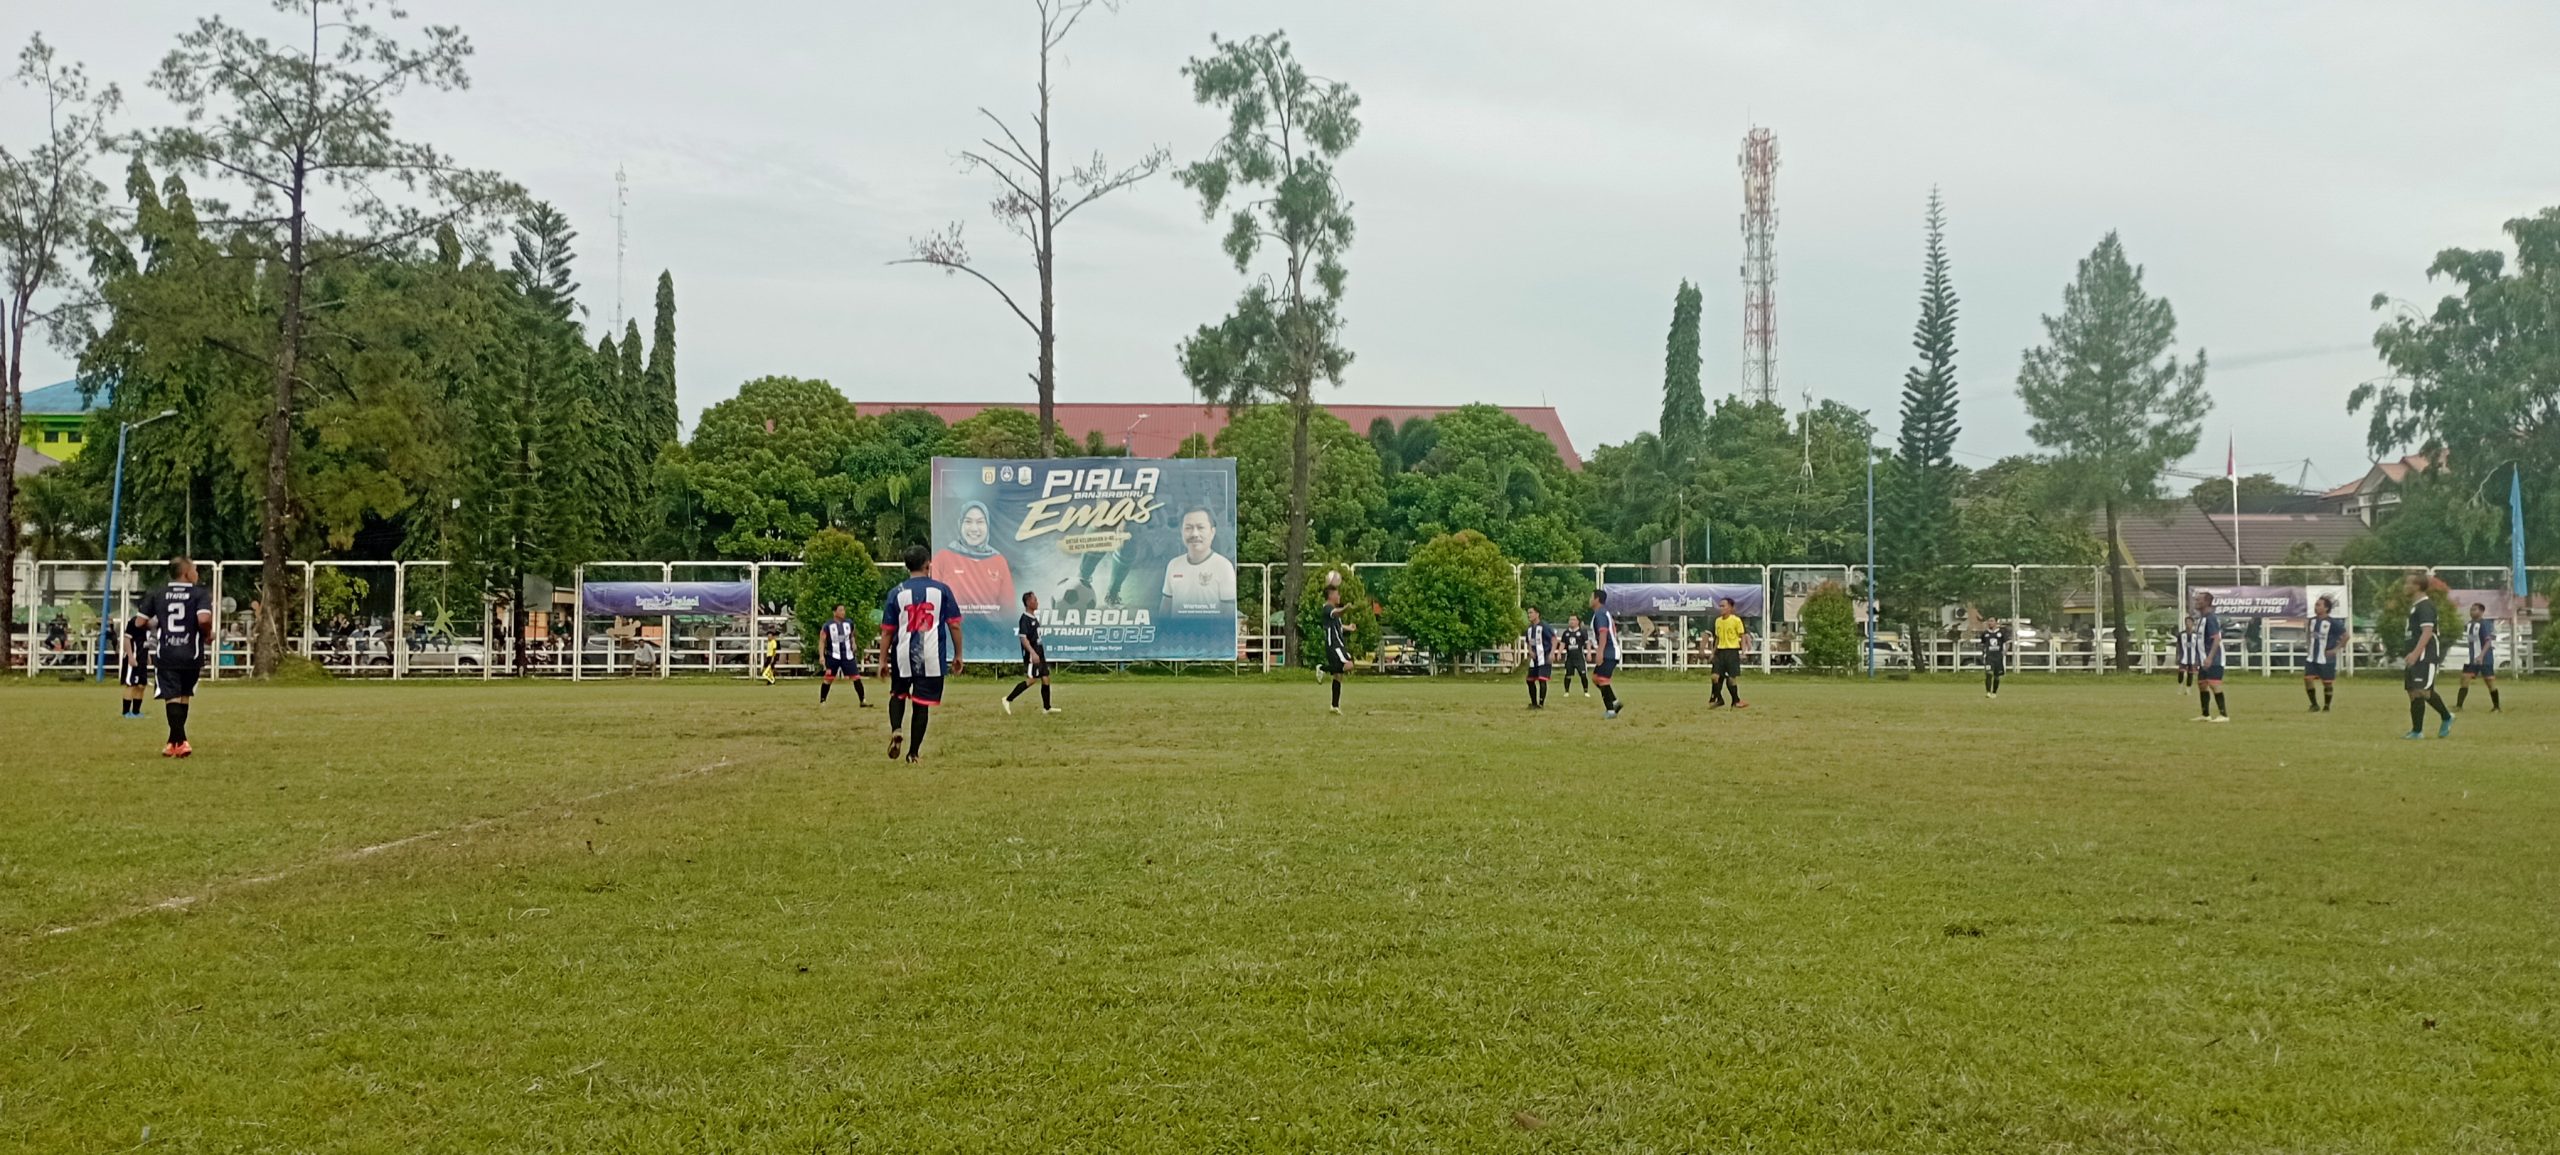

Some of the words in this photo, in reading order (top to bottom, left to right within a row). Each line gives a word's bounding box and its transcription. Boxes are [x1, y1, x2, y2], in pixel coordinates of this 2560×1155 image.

[1041, 467, 1160, 499] PIALA
[1014, 493, 1166, 541] Emas
[2211, 597, 2253, 606] UNJUNG
[2255, 597, 2290, 606] TINGGI
[167, 602, 185, 632] 2
[903, 602, 936, 633] 16
[1084, 609, 1151, 625] BOLA
[1053, 627, 1093, 636] TAHUN
[1091, 626, 1156, 643] 2025
